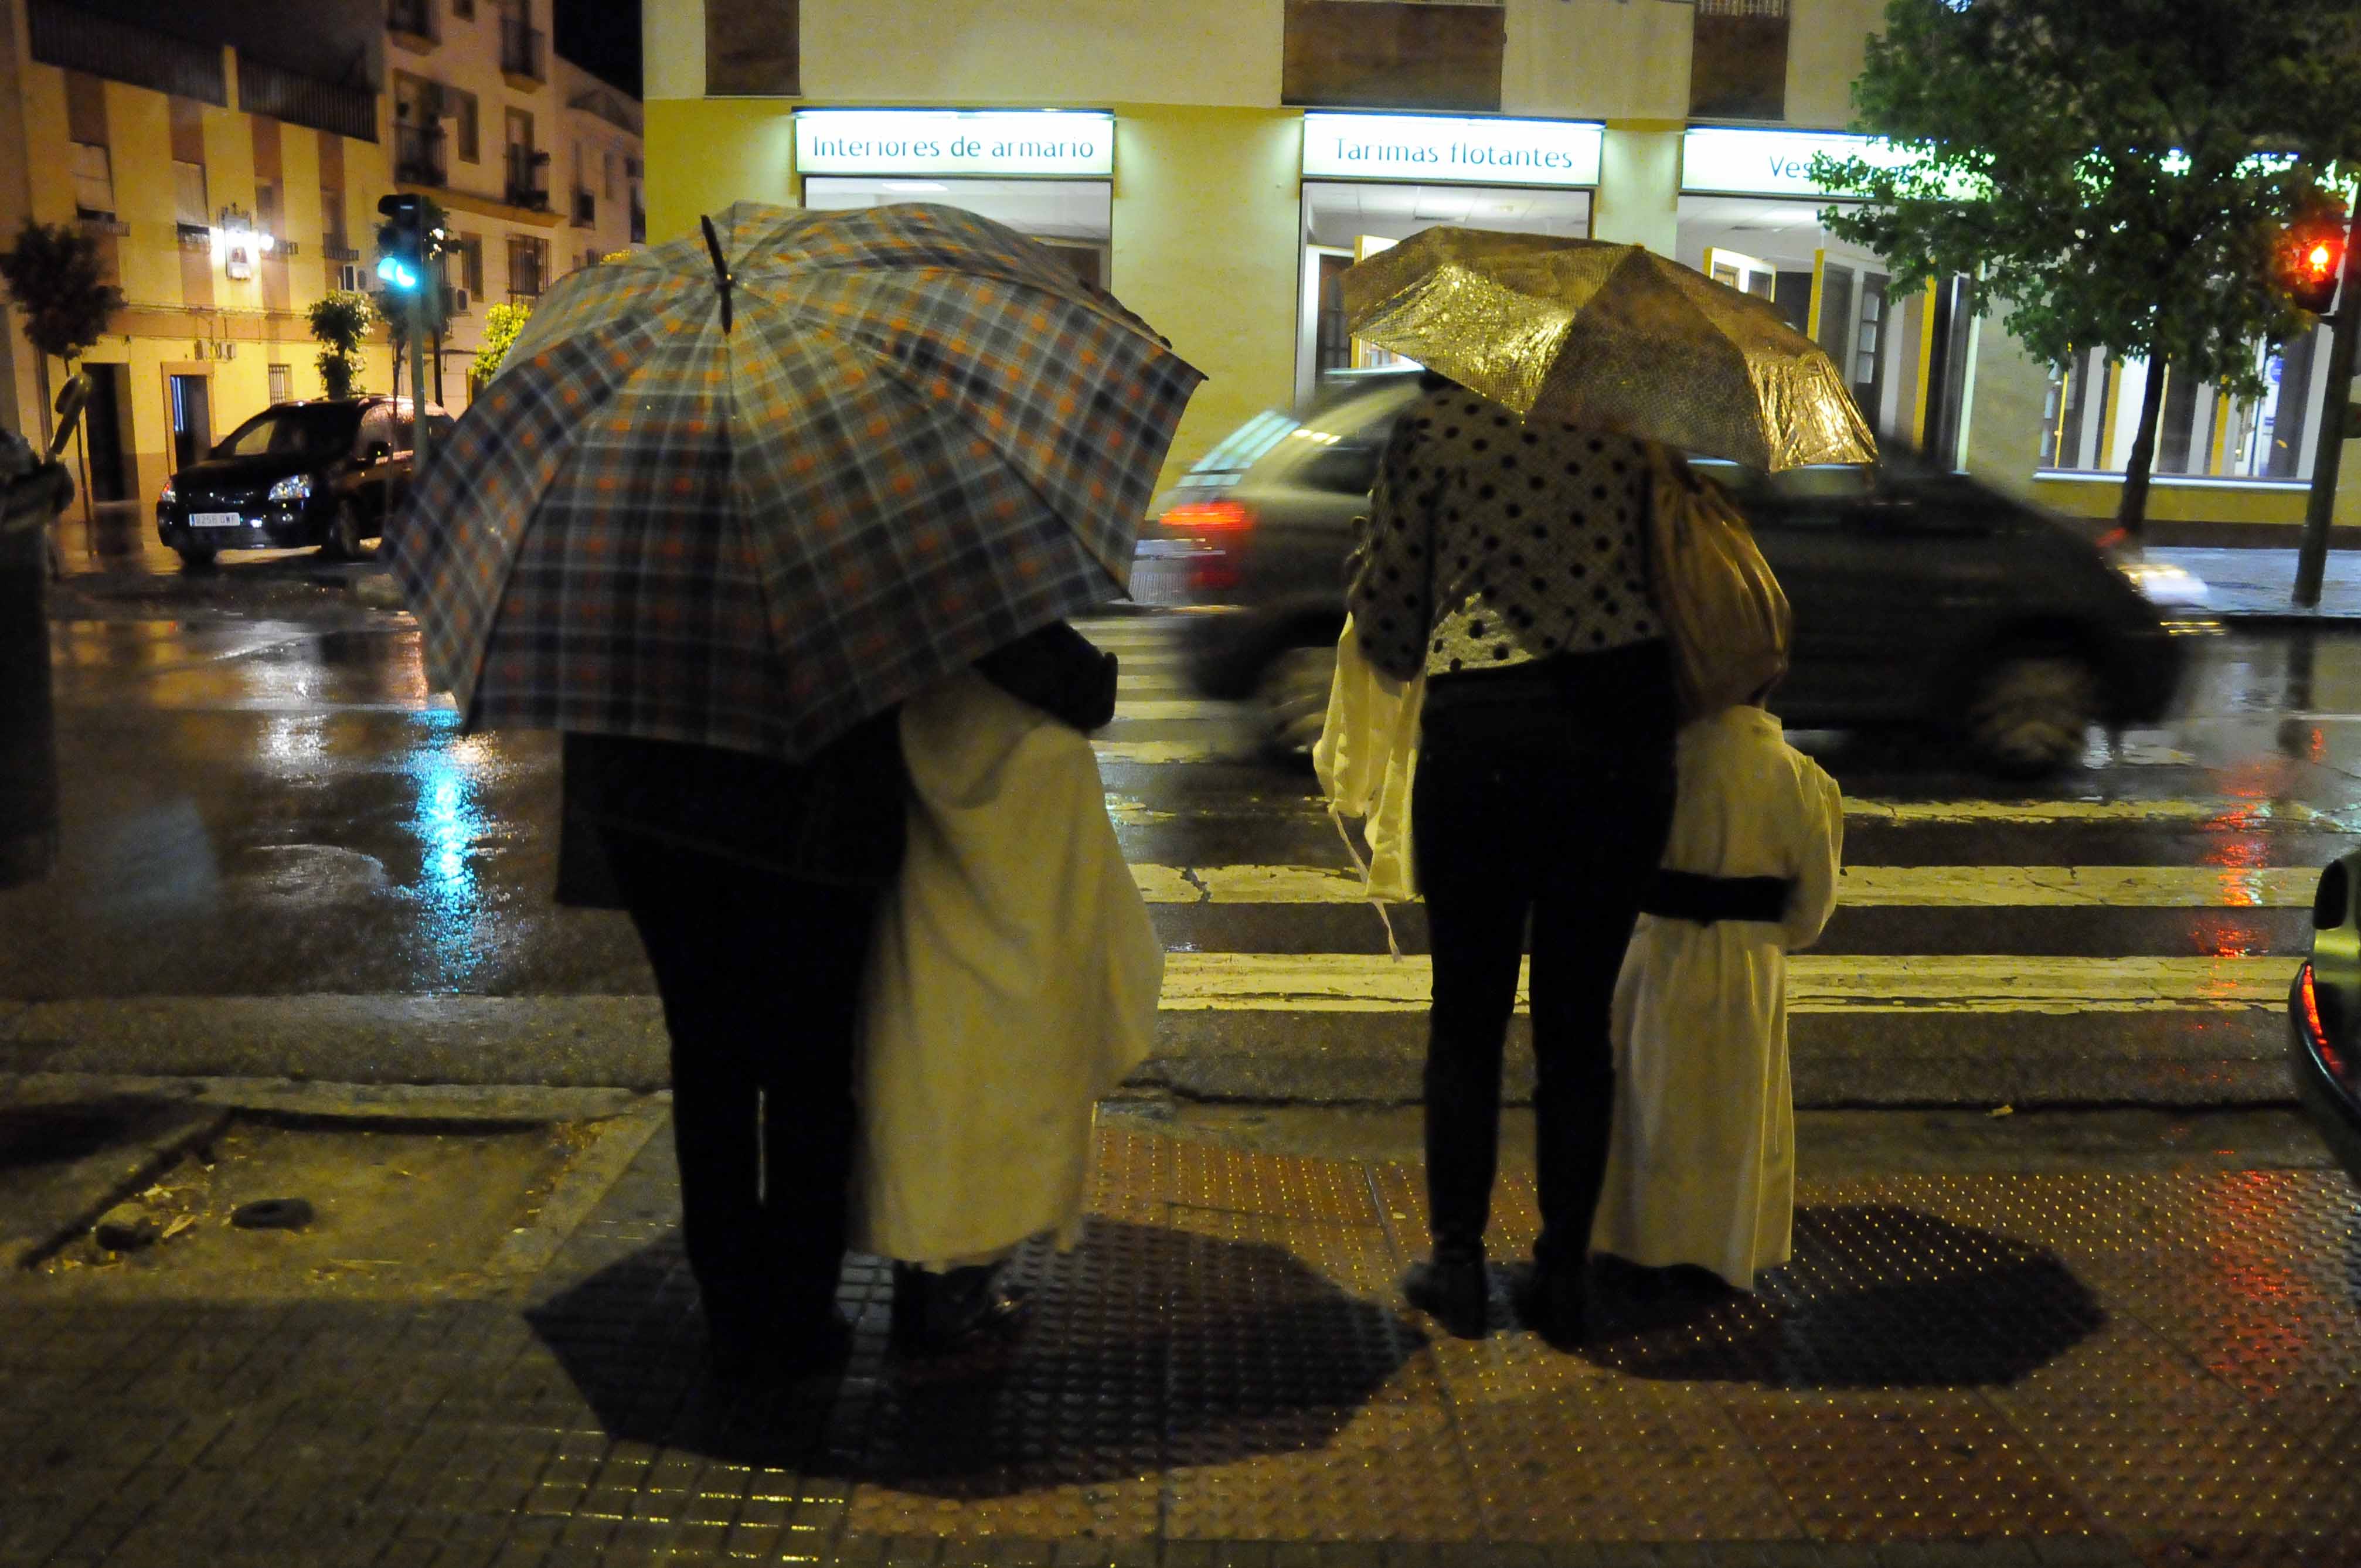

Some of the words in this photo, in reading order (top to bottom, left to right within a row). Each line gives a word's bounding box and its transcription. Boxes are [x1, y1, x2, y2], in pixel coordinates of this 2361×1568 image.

[814, 135, 940, 157] Interiores
[950, 135, 981, 157] de
[991, 137, 1094, 158] armario
[1336, 138, 1438, 163] Tarimas
[1450, 142, 1573, 169] flotantes
